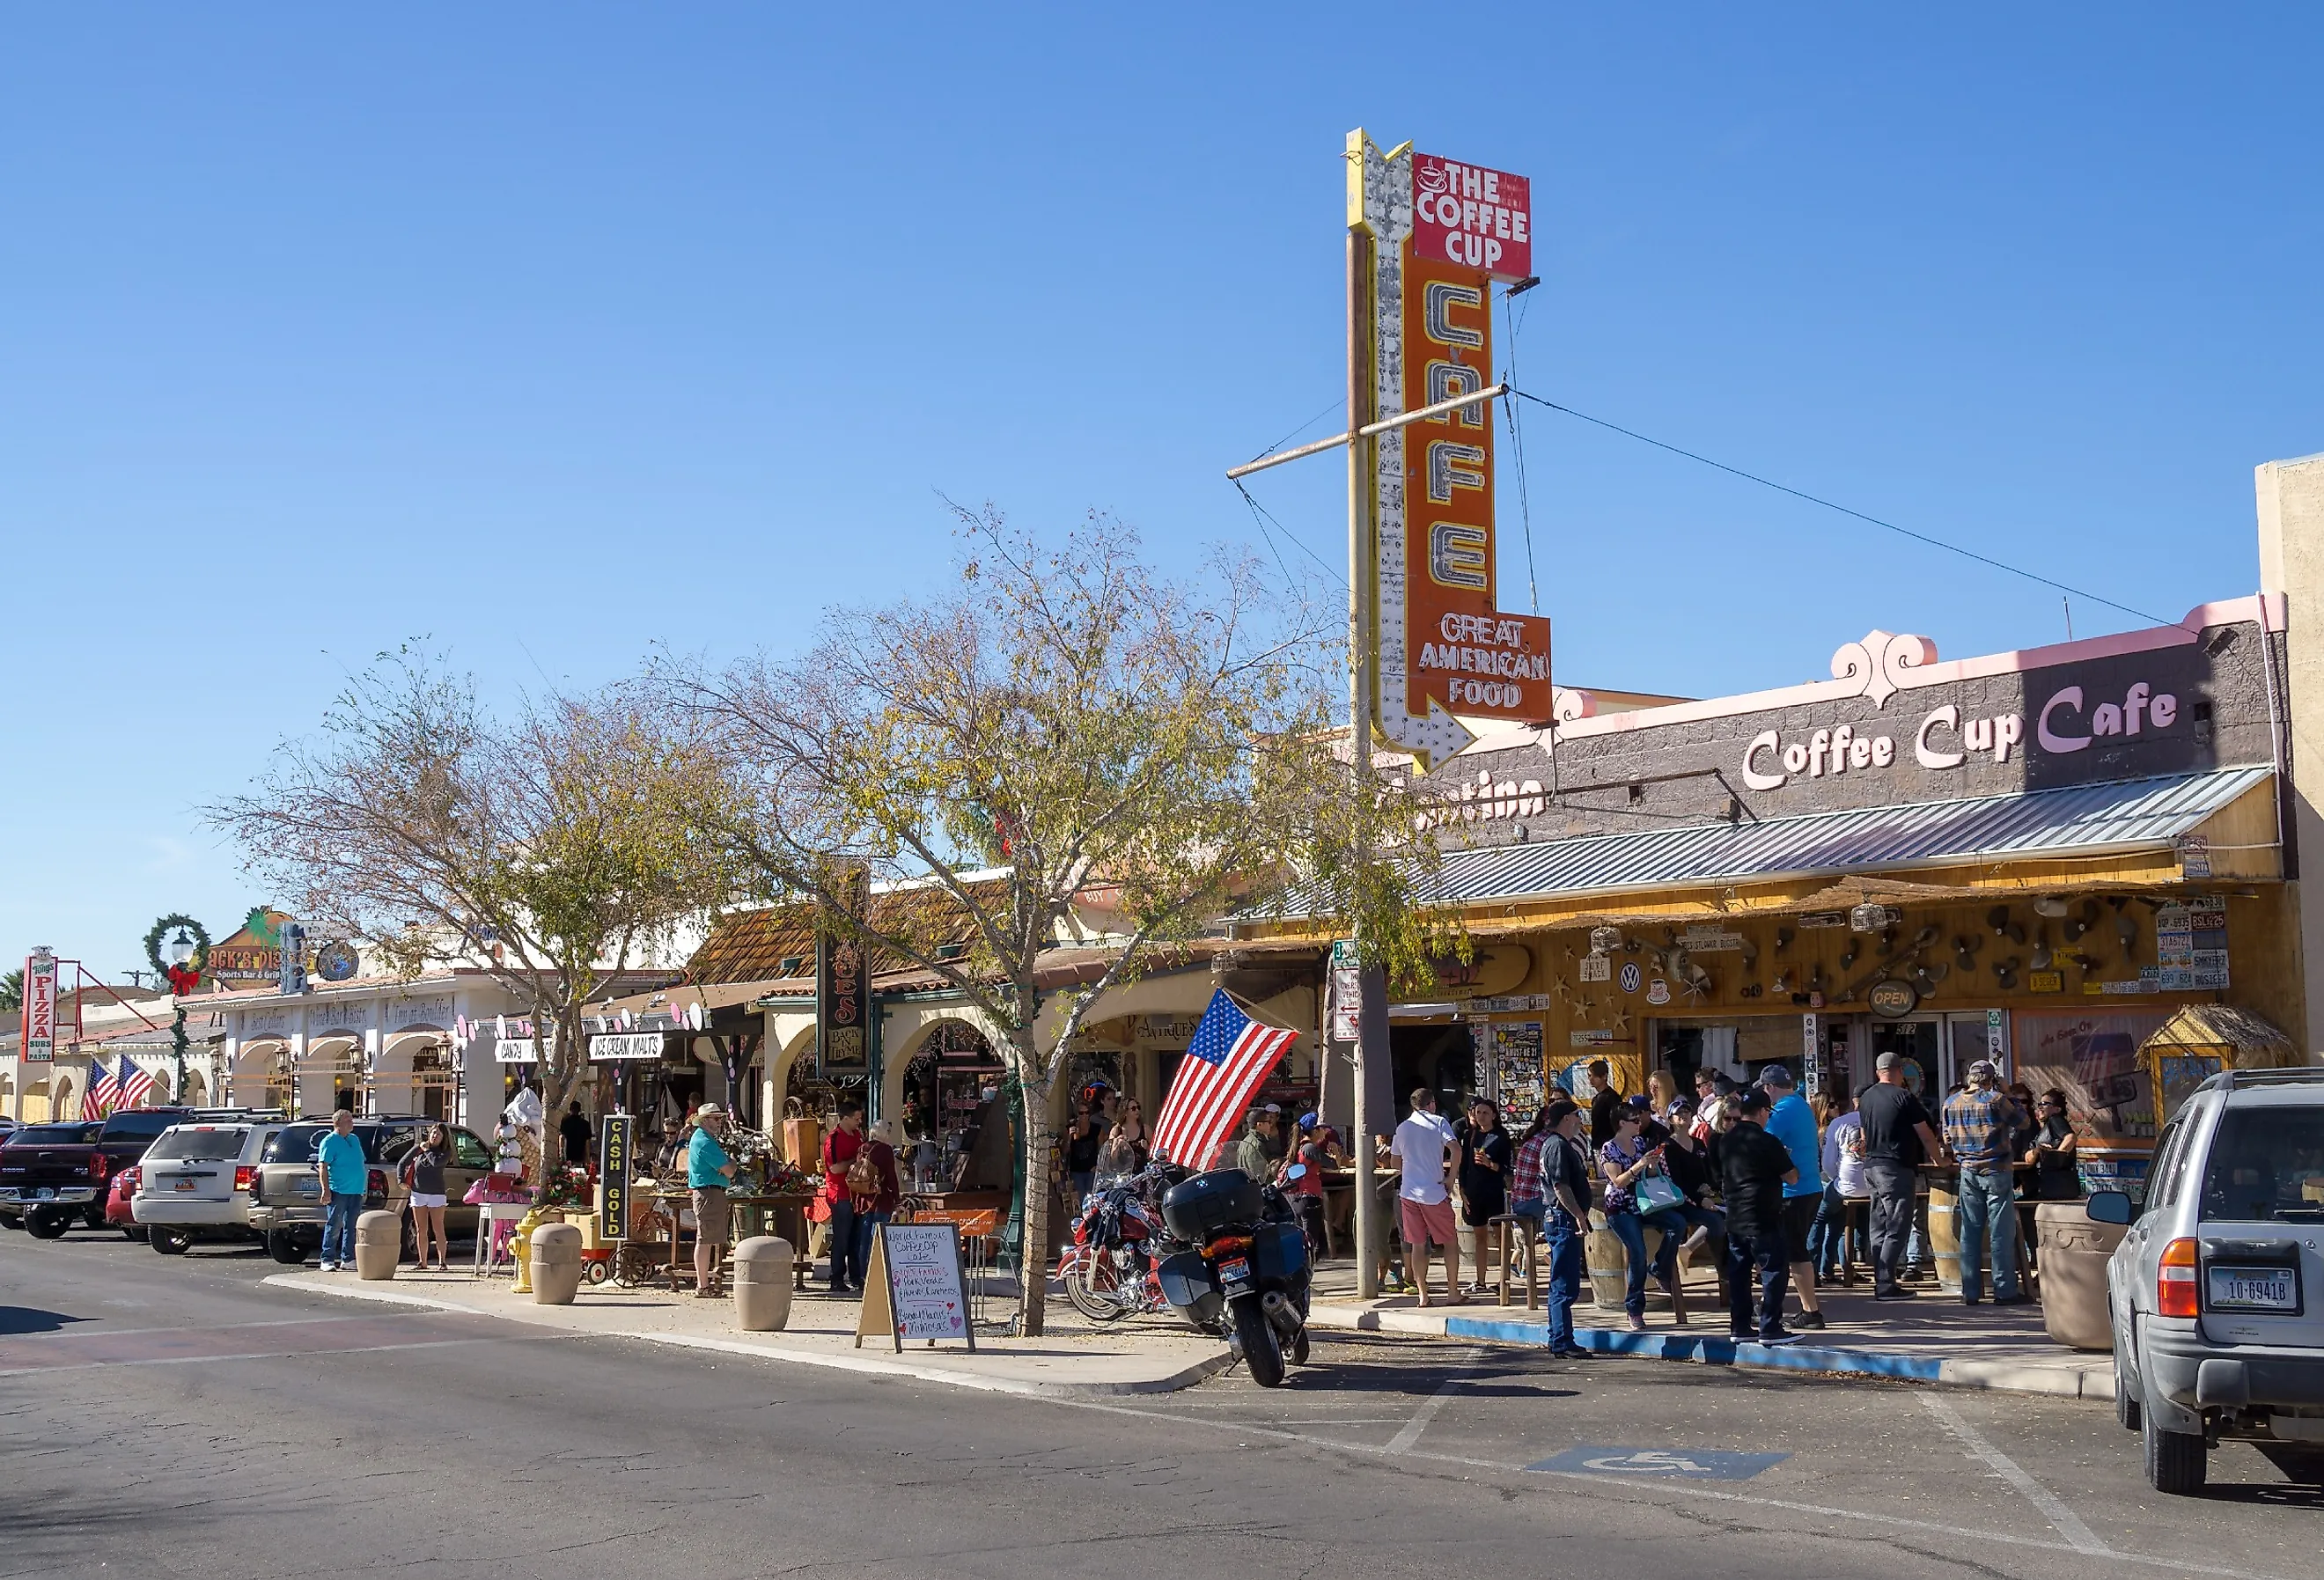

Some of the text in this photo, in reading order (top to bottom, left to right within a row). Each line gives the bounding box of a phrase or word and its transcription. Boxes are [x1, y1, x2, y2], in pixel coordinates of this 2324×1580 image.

[1445, 162, 1500, 204] THE
[1416, 191, 1528, 244] COFFEE
[1445, 231, 1503, 269] CUP
[1423, 279, 1488, 592] CAFE
[1440, 612, 1526, 649] GREAT
[1418, 643, 1550, 680] AMERICAN
[1449, 677, 1522, 709] FOOD
[1742, 682, 2177, 790] Coffee Cup Cafe
[1084, 890, 1104, 903] BUY
[217, 970, 242, 979] Sports
[31, 976, 52, 1038] PIZZA
[1874, 992, 1908, 1005] OPEN
[832, 1031, 859, 1044] BACK
[842, 1037, 851, 1047] IN
[1896, 1024, 1916, 1034] 512
[501, 1042, 521, 1059] CANDY
[595, 1036, 658, 1056] ICE CREAM MALTS
[607, 1121, 622, 1235] CASH GOLD
[887, 1231, 913, 1242] World
